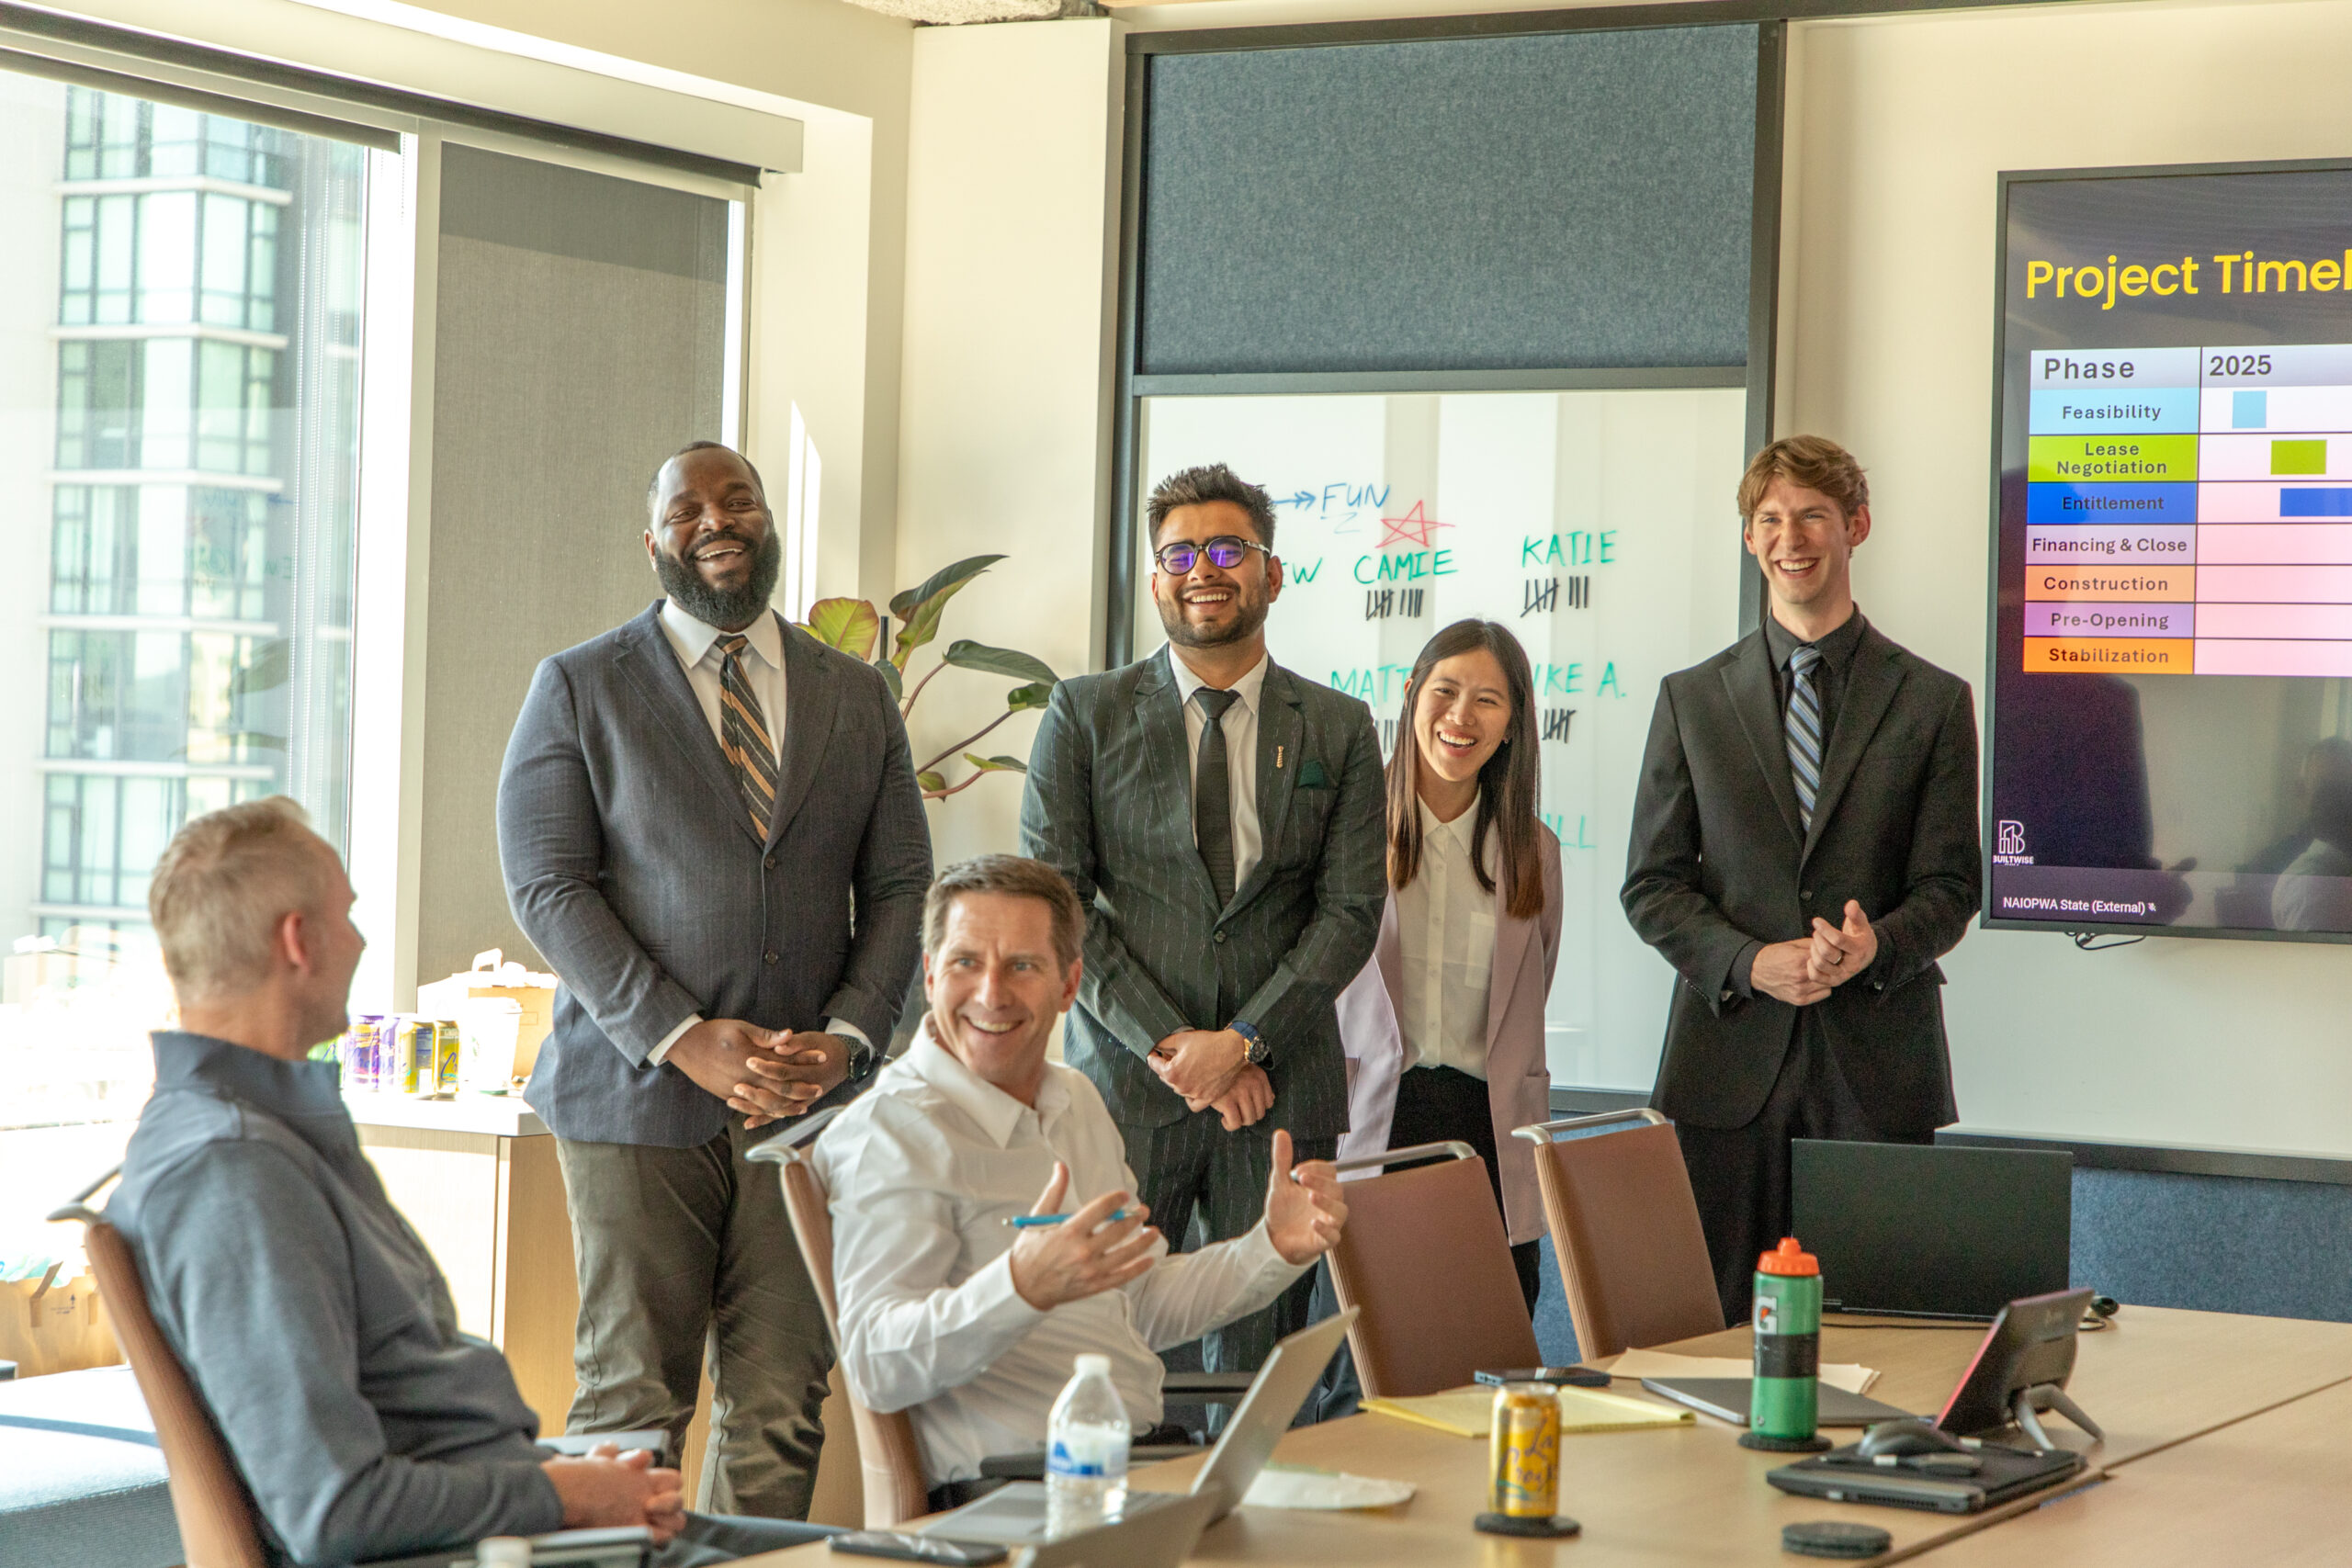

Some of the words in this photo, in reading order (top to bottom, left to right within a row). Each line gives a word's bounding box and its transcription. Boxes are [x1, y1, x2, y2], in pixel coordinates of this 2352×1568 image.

[2027, 254, 2199, 310] Project
[2043, 357, 2135, 380] Phase
[2209, 355, 2272, 377] 2025
[2062, 403, 2162, 422] Feasibility
[2085, 442, 2141, 457] Lease
[2056, 459, 2167, 479] Negotiation
[1322, 482, 1391, 513] FUN
[2062, 495, 2165, 512] Entitlement
[2032, 537, 2116, 555] Financing
[2120, 538, 2132, 552] &
[2137, 536, 2188, 553] Close
[1354, 548, 1459, 584] CAMIE
[1521, 530, 1618, 569] KATIE
[2043, 575, 2168, 592] Construction
[2051, 612, 2169, 631] Pre-Opening
[2049, 648, 2169, 663] Stabilization
[1597, 660, 1627, 698] A.
[2003, 897, 2058, 910] NAIOPWA
[2060, 898, 2089, 911] State
[2092, 900, 2145, 916] (External)
[1755, 1294, 1778, 1336] G
